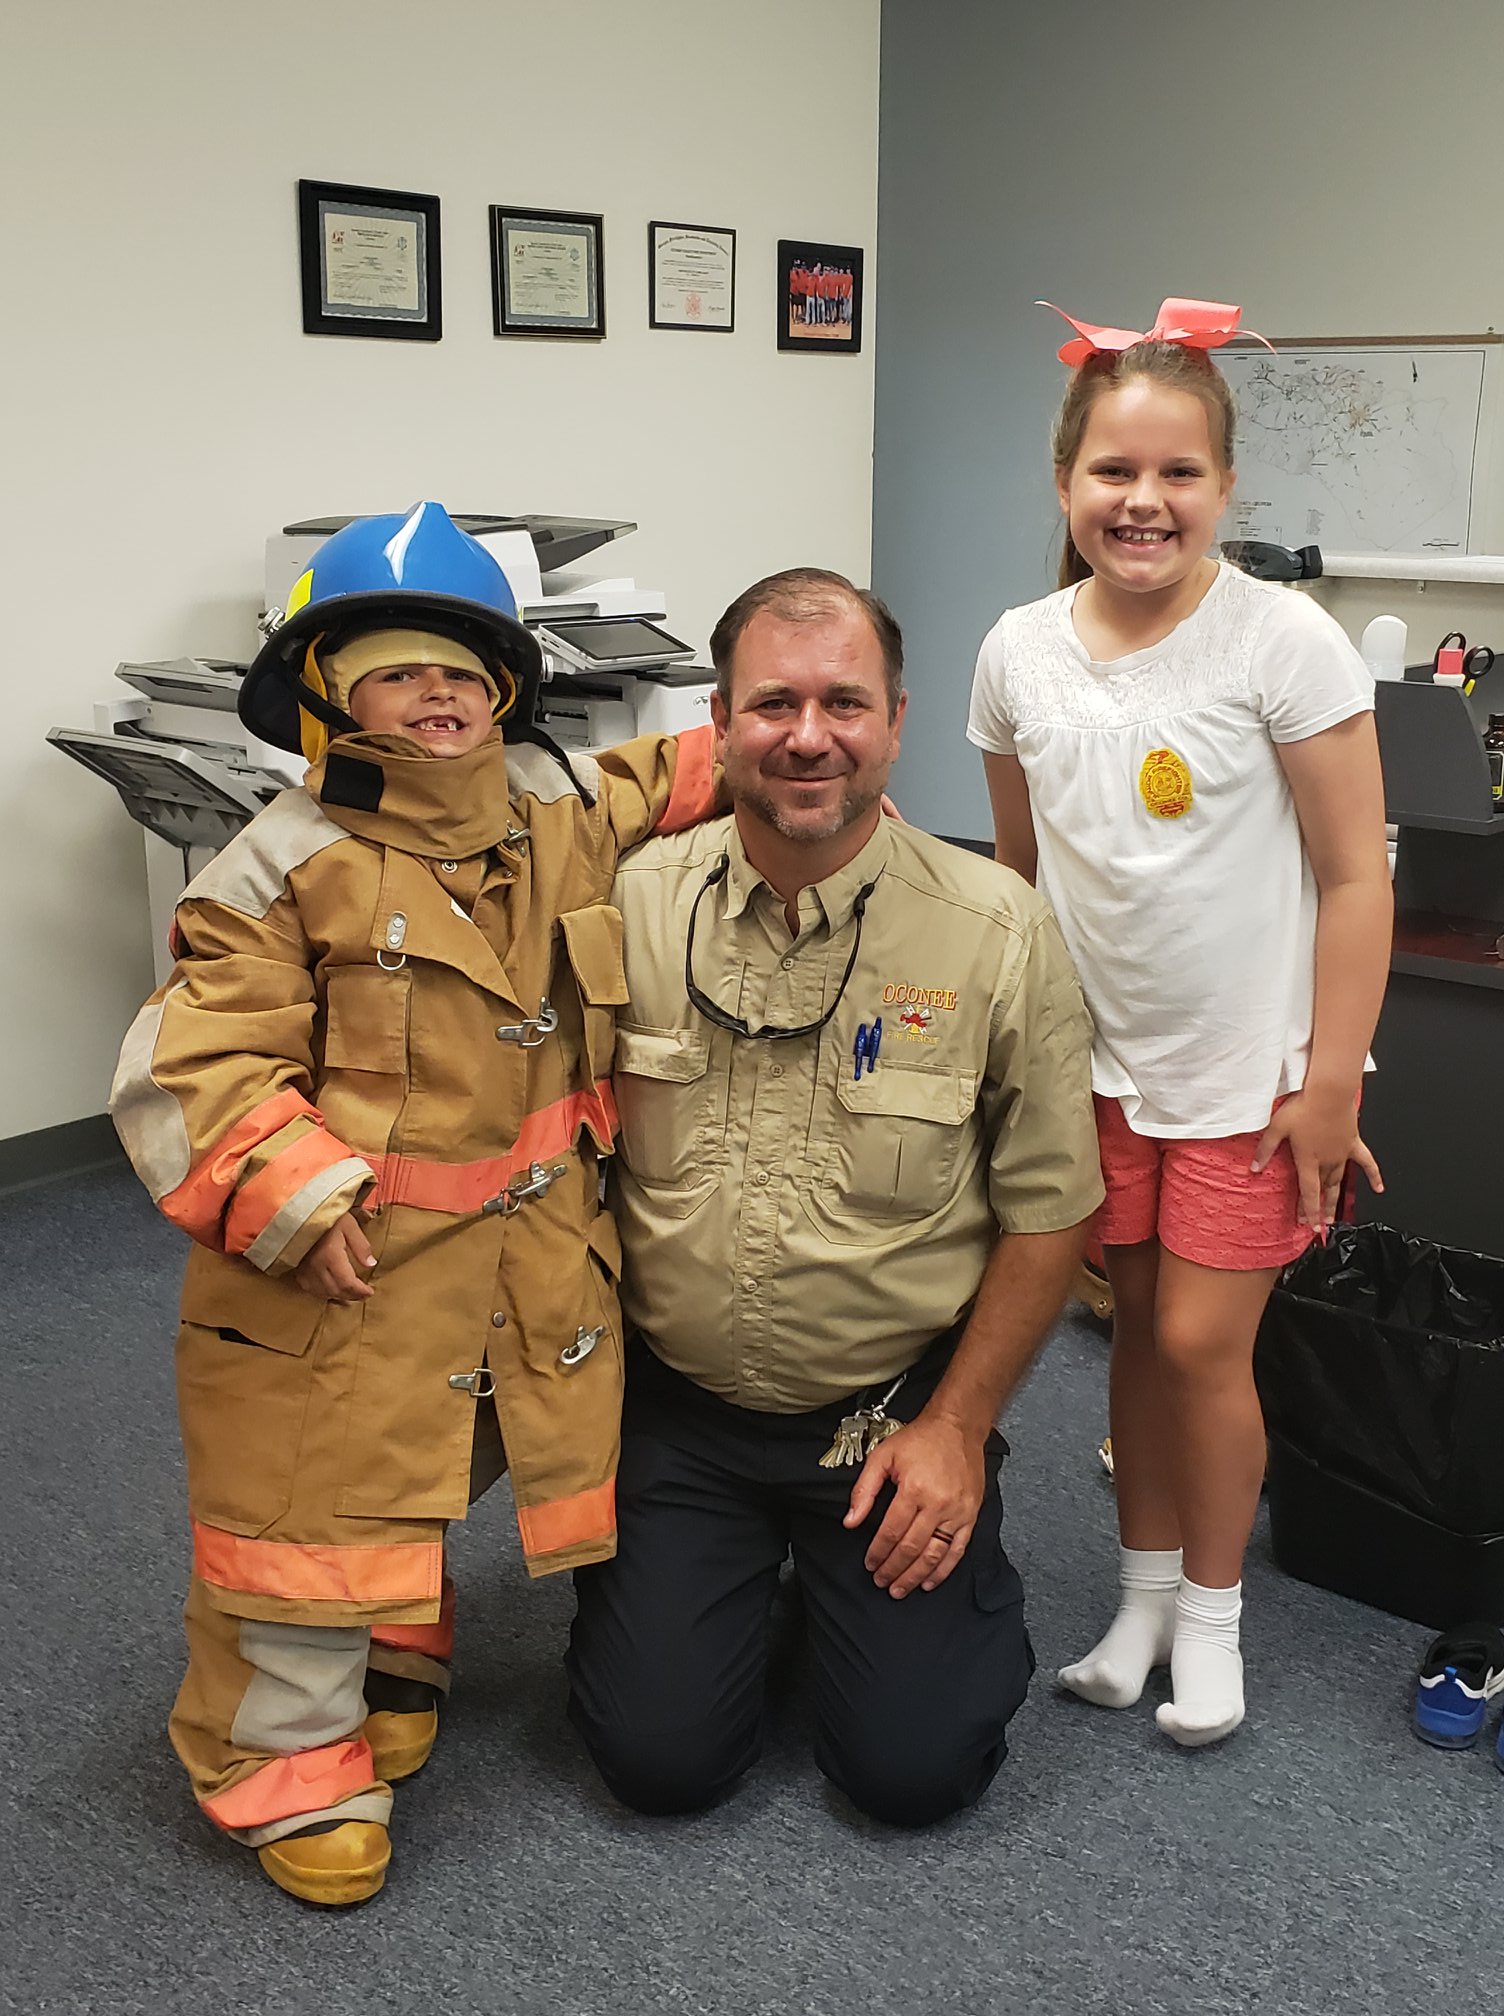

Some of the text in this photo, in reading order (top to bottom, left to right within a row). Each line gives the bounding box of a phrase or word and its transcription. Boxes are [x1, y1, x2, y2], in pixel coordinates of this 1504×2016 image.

[883, 983, 957, 1010] OCONEE
[886, 1031, 941, 1044] FIRE RESCUE
